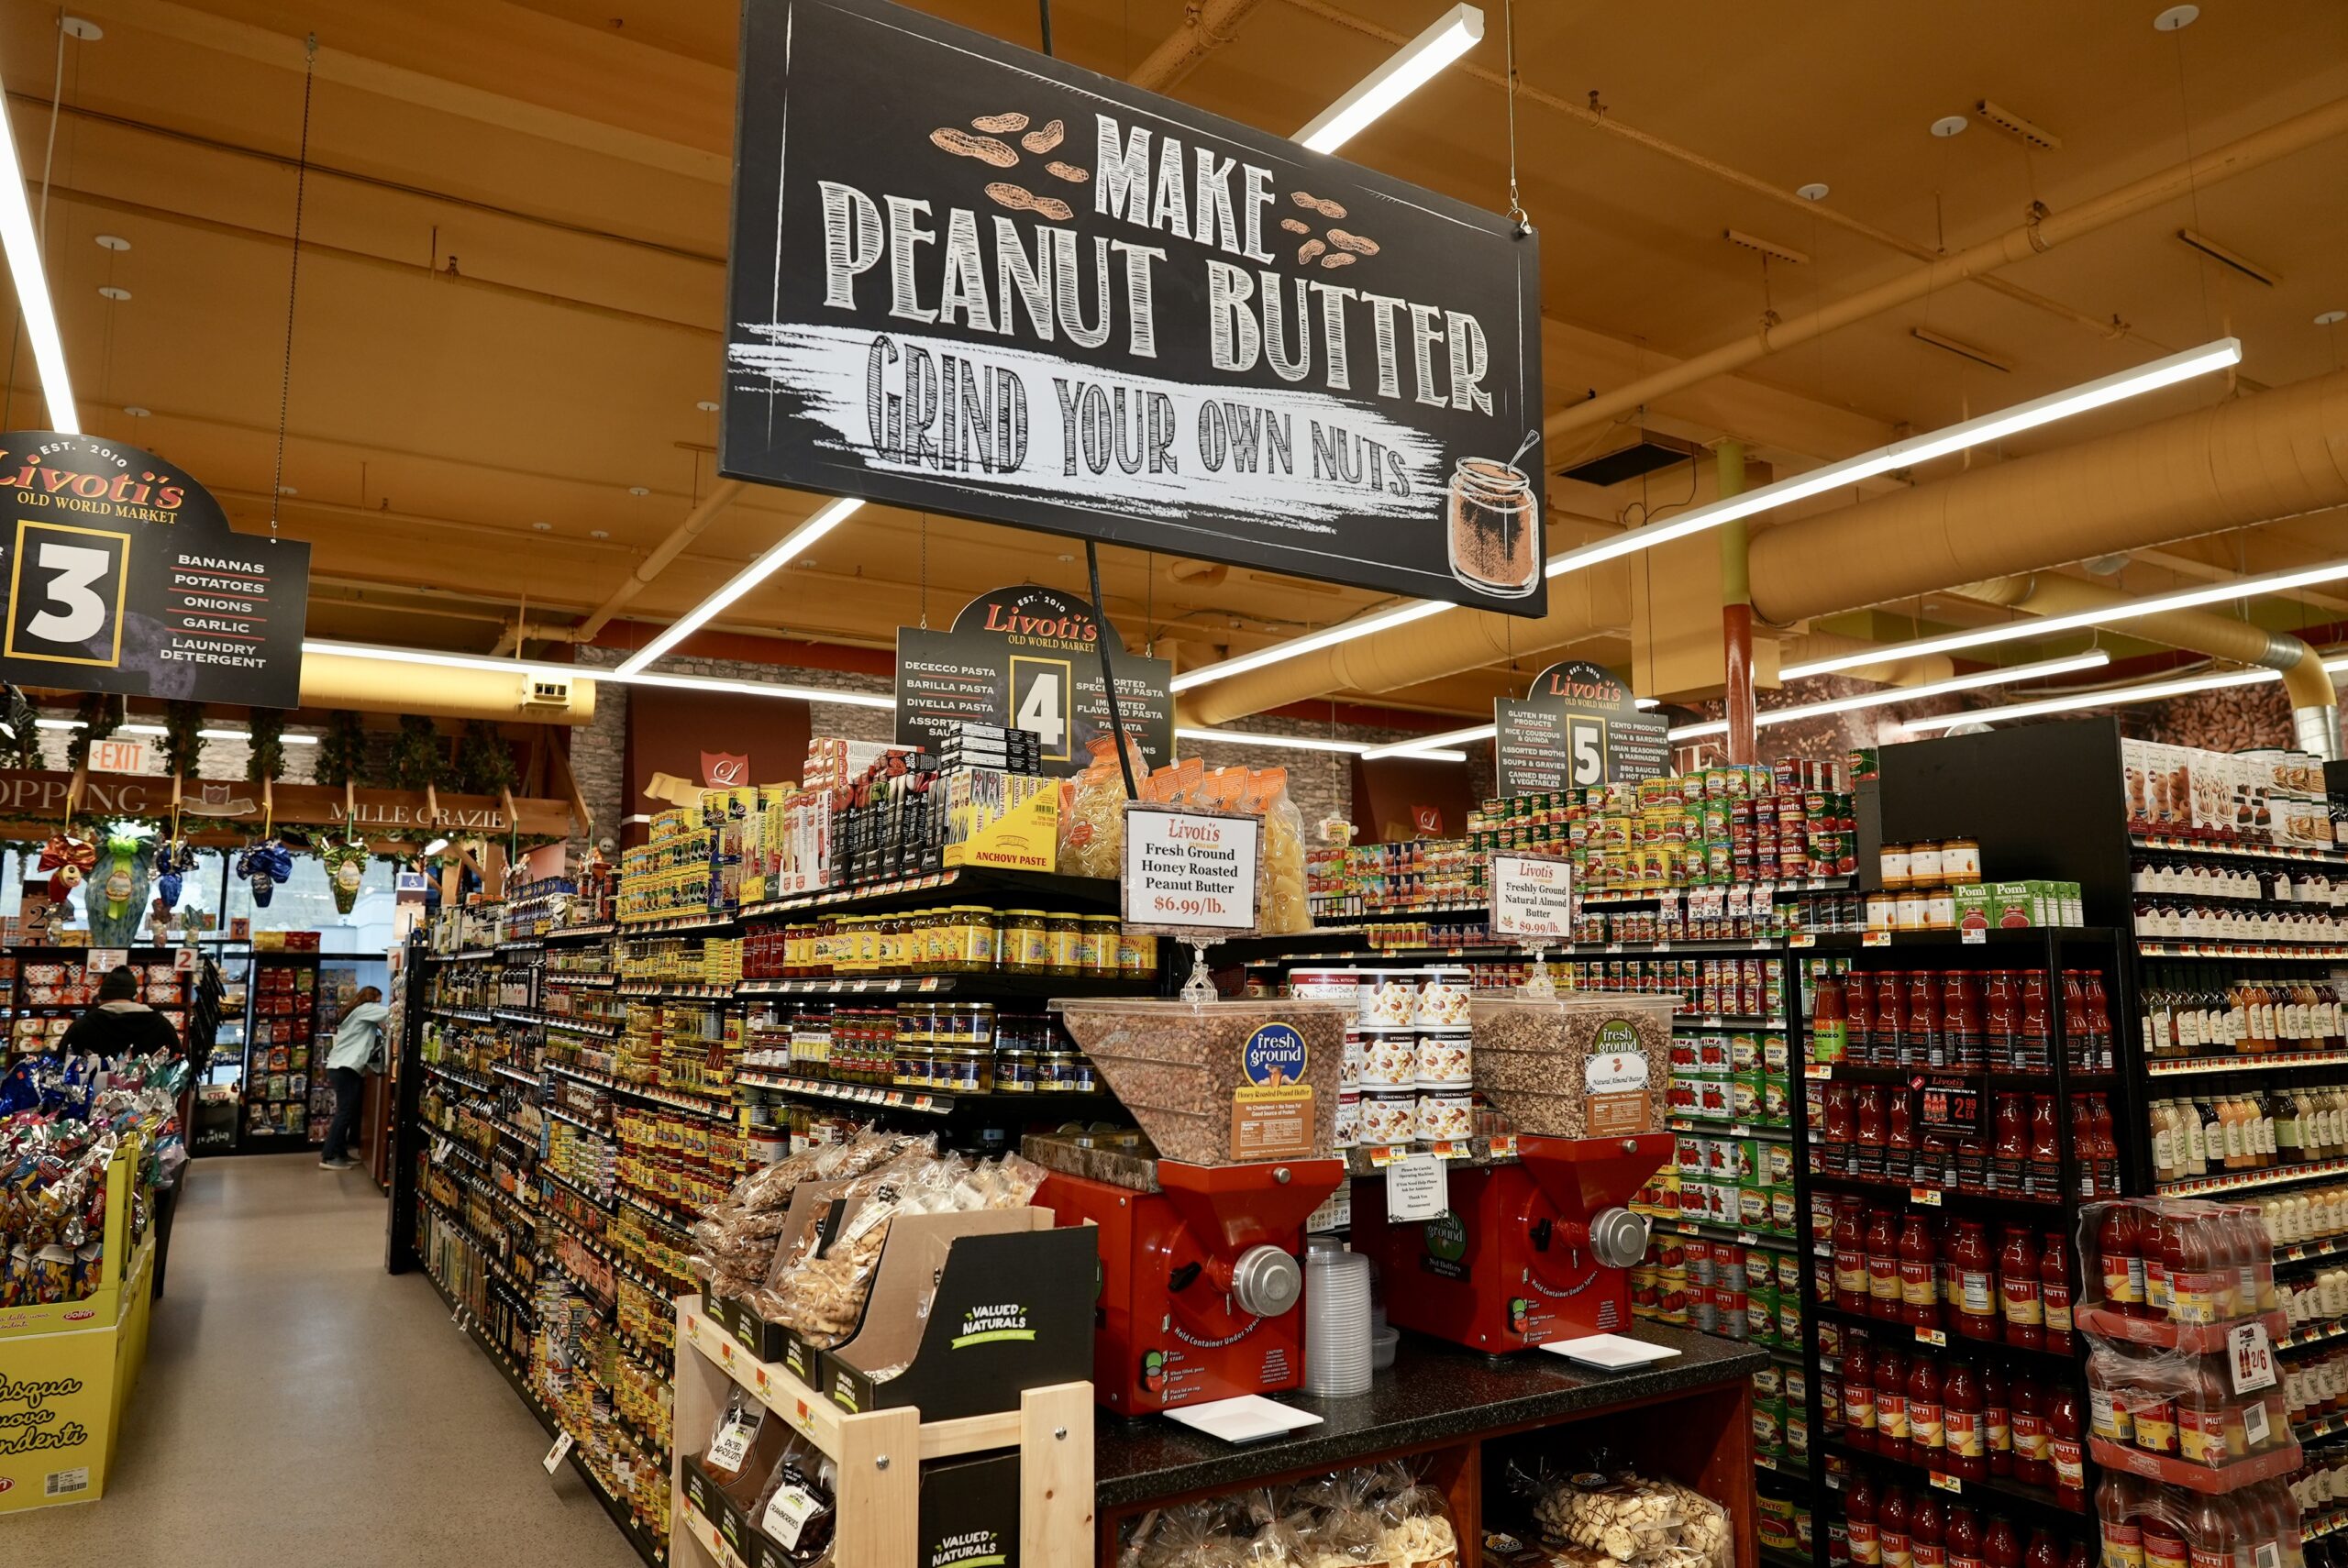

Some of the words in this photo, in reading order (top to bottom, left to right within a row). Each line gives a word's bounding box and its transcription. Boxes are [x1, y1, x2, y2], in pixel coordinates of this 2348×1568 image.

[1095, 114, 1276, 264] MAKE
[817, 181, 1167, 358] PEANUT
[1206, 259, 1492, 416] BUTTER
[868, 334, 1029, 473] GRIND
[1052, 378, 1178, 476] YOUR
[1200, 399, 1292, 475] OWN
[1311, 419, 1411, 497] NUTS
[40, 442, 75, 455] EST.
[90, 445, 127, 467] 2010
[17, 491, 50, 506] OLD
[55, 497, 110, 514] WORLD
[116, 507, 177, 524] MARKET
[178, 555, 264, 573] BANANAS
[175, 575, 264, 593] POTATOES
[27, 543, 109, 643] 3
[183, 597, 252, 613] ONIONS
[1018, 595, 1037, 606] EST.
[1044, 596, 1066, 613] 2010
[183, 618, 249, 633] GARLIC
[984, 603, 1097, 641] Livoti's
[172, 638, 256, 655] LAUNDRY
[1008, 635, 1026, 645] OLD
[1028, 637, 1058, 648] WORLD
[1061, 641, 1095, 653] MARKET
[161, 650, 266, 668] DETERGENT
[905, 661, 958, 673] DECECCO
[961, 667, 995, 677] PASTA
[1586, 666, 1600, 679] 2010
[906, 680, 957, 691] BARILLA
[960, 685, 994, 694] PASTA
[1096, 677, 1146, 688] IMORTED
[1550, 673, 1621, 701] Livoti's
[1134, 689, 1164, 697] PASTA
[907, 699, 955, 709] DIVELLA
[959, 703, 994, 712] PASTA
[1017, 673, 1064, 745] 4
[1565, 698, 1576, 706] OLD
[1578, 700, 1597, 708] WORLD
[1599, 701, 1620, 711] MARKET
[1508, 711, 1536, 720] GLUTEN
[1514, 719, 1551, 728] PRODUCTS
[1611, 722, 1632, 730] CENTO
[1634, 723, 1666, 733] PRODUCTS
[1526, 730, 1560, 739] COUSCOUS
[1635, 735, 1667, 745] SARDINES
[100, 743, 142, 770] EXIT
[1501, 746, 1537, 756] ASSORTED
[1575, 726, 1600, 785] 5
[1610, 745, 1628, 753] ASIAN
[1630, 747, 1668, 756] SEASONINGS
[1624, 754, 1660, 762] MARINADES
[1535, 760, 1565, 769] GRAVIES
[1509, 771, 1536, 779] CANNED
[1537, 773, 1560, 781] BEANS
[1517, 778, 1559, 788] VEGETABLES
[330, 803, 409, 823] MILLE
[1168, 818, 1220, 842] Livoti's
[1146, 843, 1183, 856] Fresh
[1188, 845, 1235, 860] Ground
[976, 852, 1017, 863] ANCHOVY
[1020, 856, 1047, 867] PASTE
[1142, 860, 1186, 876] Honey
[1190, 864, 1238, 878] Roasted
[1520, 863, 1553, 878] Livoti's
[1146, 878, 1192, 890] Peanut
[1196, 881, 1235, 893] Butter
[1506, 882, 1537, 894] Freshly
[1539, 885, 1566, 895] Ground
[1958, 886, 1987, 897] Pomì
[1997, 883, 2026, 895] Pomì
[1155, 895, 1225, 916] $6.99/lb.
[1505, 895, 1536, 905] Natural
[1539, 898, 1567, 907] Almond
[28, 906, 46, 929] 2
[1526, 909, 1550, 918] Butter
[1520, 921, 1560, 933] $9.99/lb.
[179, 952, 192, 967] 2
[392, 952, 402, 970] 1
[1257, 1033, 1295, 1048] fresh
[1603, 1028, 1632, 1041] fresh
[1599, 1039, 1637, 1053] ground
[1250, 1046, 1301, 1066] ground
[1238, 1090, 1253, 1099] Honey
[1955, 1098, 1964, 1118] 2
[1966, 1099, 1976, 1109] 99
[1428, 1226, 1463, 1242] ground
[1902, 1265, 1922, 1274] MUTTI
[1532, 1279, 1543, 1291] Hold
[1544, 1287, 1568, 1297] Container
[1569, 1285, 1585, 1296] Under
[2004, 1283, 2028, 1292] MUTTI
[2044, 1288, 2067, 1298] MUTTI
[972, 1304, 1019, 1318] VALUED
[963, 1317, 1026, 1335] NATURALS
[1163, 1314, 1170, 1332] 1
[1175, 1327, 1189, 1342] Hold
[1190, 1338, 1223, 1347] Container
[1224, 1331, 1245, 1344] Under
[2252, 1349, 2267, 1370] 2/6
[724, 1439, 742, 1452] DRIED
[2054, 1442, 2080, 1454] MUTTI
[714, 1446, 742, 1463] APRICOTS
[770, 1503, 799, 1529] CRANBERRIES
[942, 1530, 990, 1549] VALUED
[933, 1542, 996, 1567] NATURALS
[2191, 1551, 2222, 1565] MUTTI
